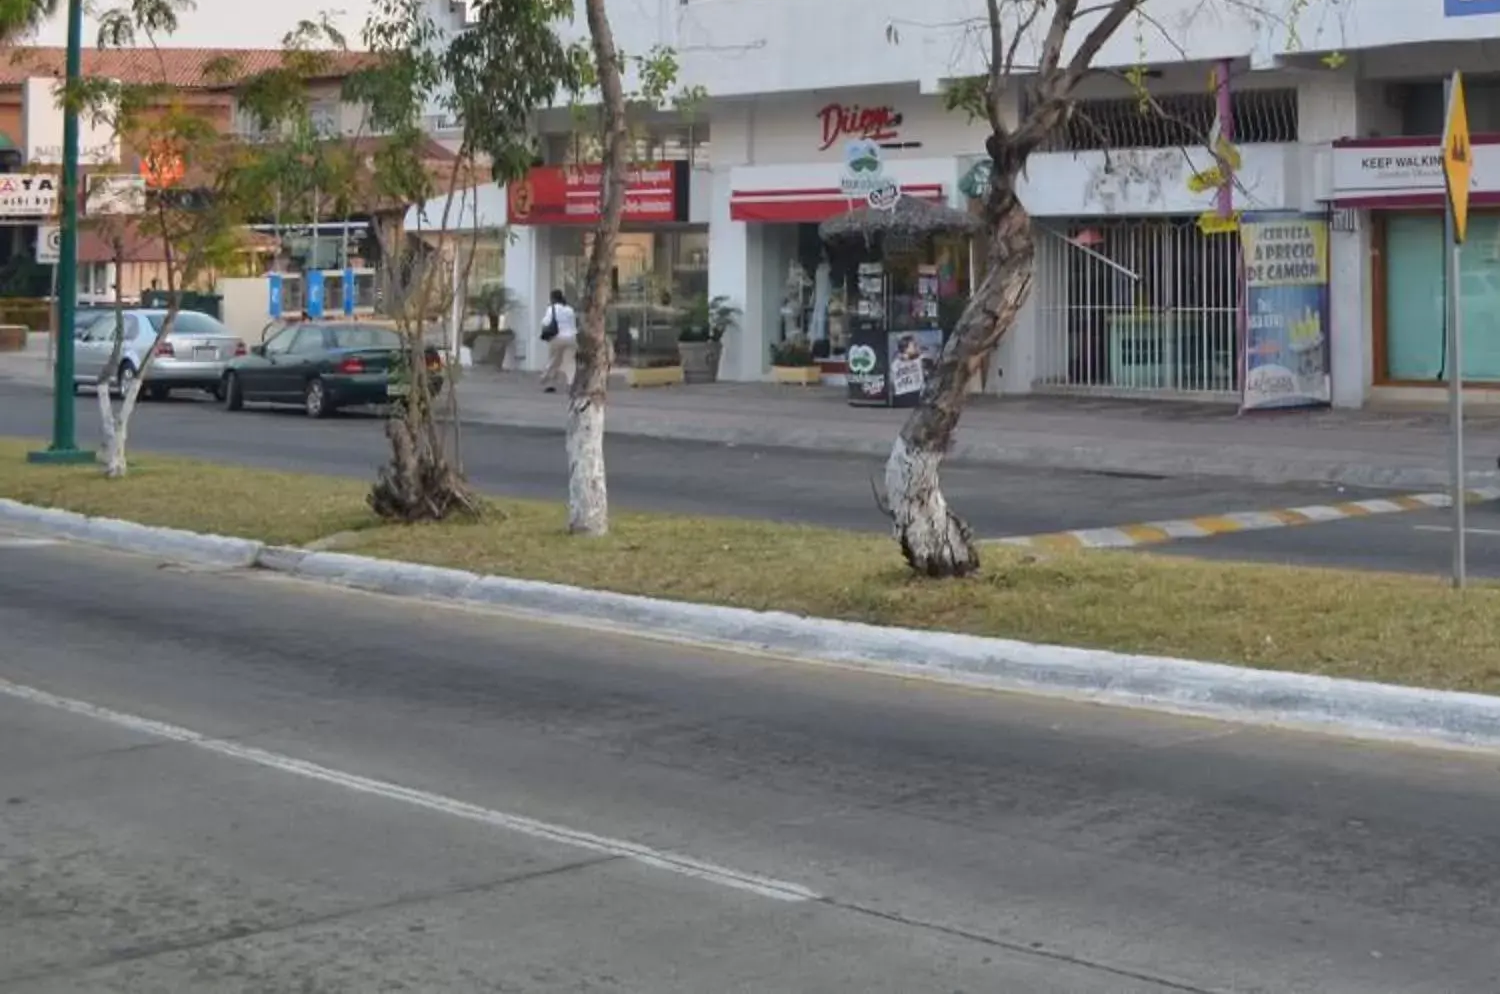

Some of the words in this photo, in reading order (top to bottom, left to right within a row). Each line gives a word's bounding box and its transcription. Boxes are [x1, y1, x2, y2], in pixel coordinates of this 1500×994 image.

[1361, 157, 1393, 169] KEEP
[1395, 155, 1443, 168] WALKIN
[1265, 242, 1315, 260] PRECIO
[1247, 265, 1264, 282] DE
